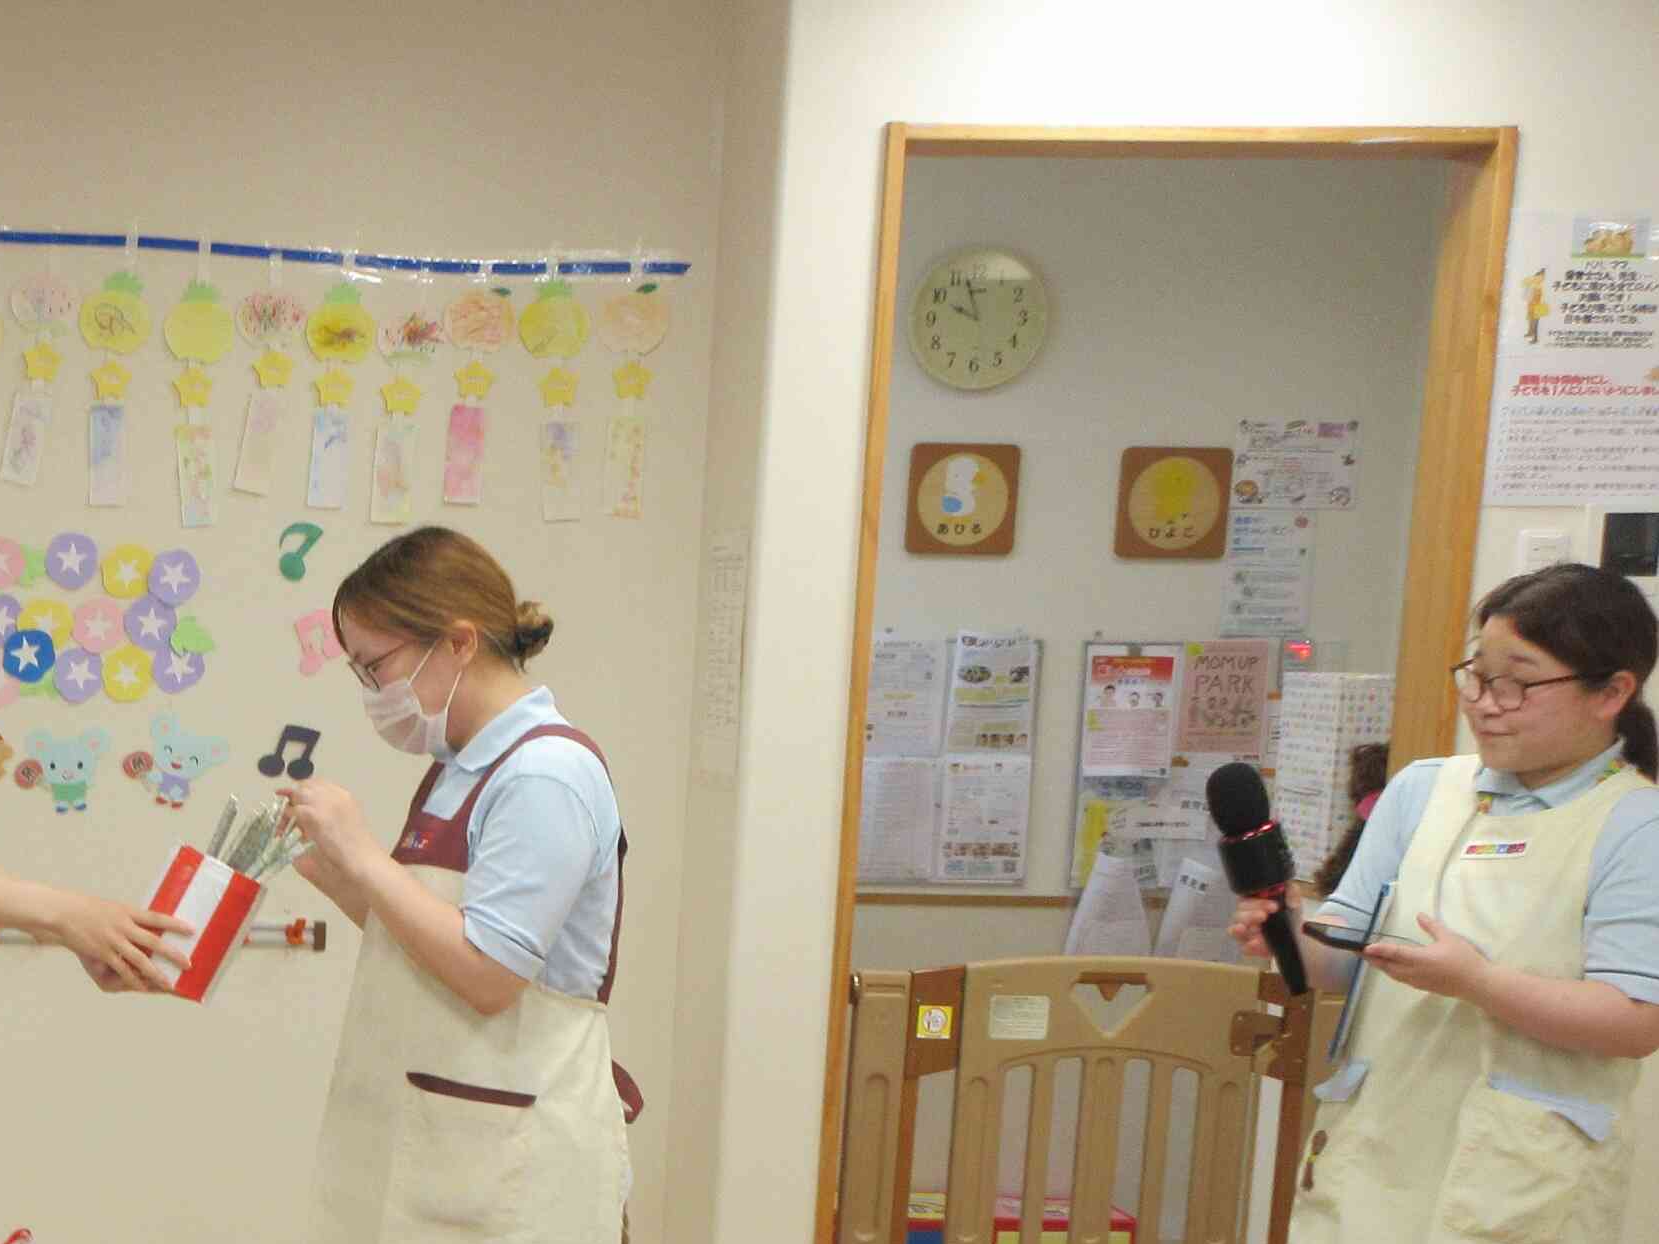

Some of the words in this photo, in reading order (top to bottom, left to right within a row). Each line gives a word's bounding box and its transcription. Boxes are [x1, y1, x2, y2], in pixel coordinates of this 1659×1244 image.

[950, 269, 962, 286] 11
[932, 287, 947, 304] 10
[1013, 287, 1024, 303] 2
[925, 311, 937, 327] 9
[1017, 311, 1029, 326] 3
[931, 335, 942, 350] 8
[1008, 333, 1019, 348] 4
[946, 352, 957, 368] 7
[968, 357, 980, 373] 6
[992, 352, 1003, 367] 5
[936, 523, 982, 534] あひる
[1148, 527, 1196, 539] ひよこ
[1193, 674, 1254, 694] PARK
